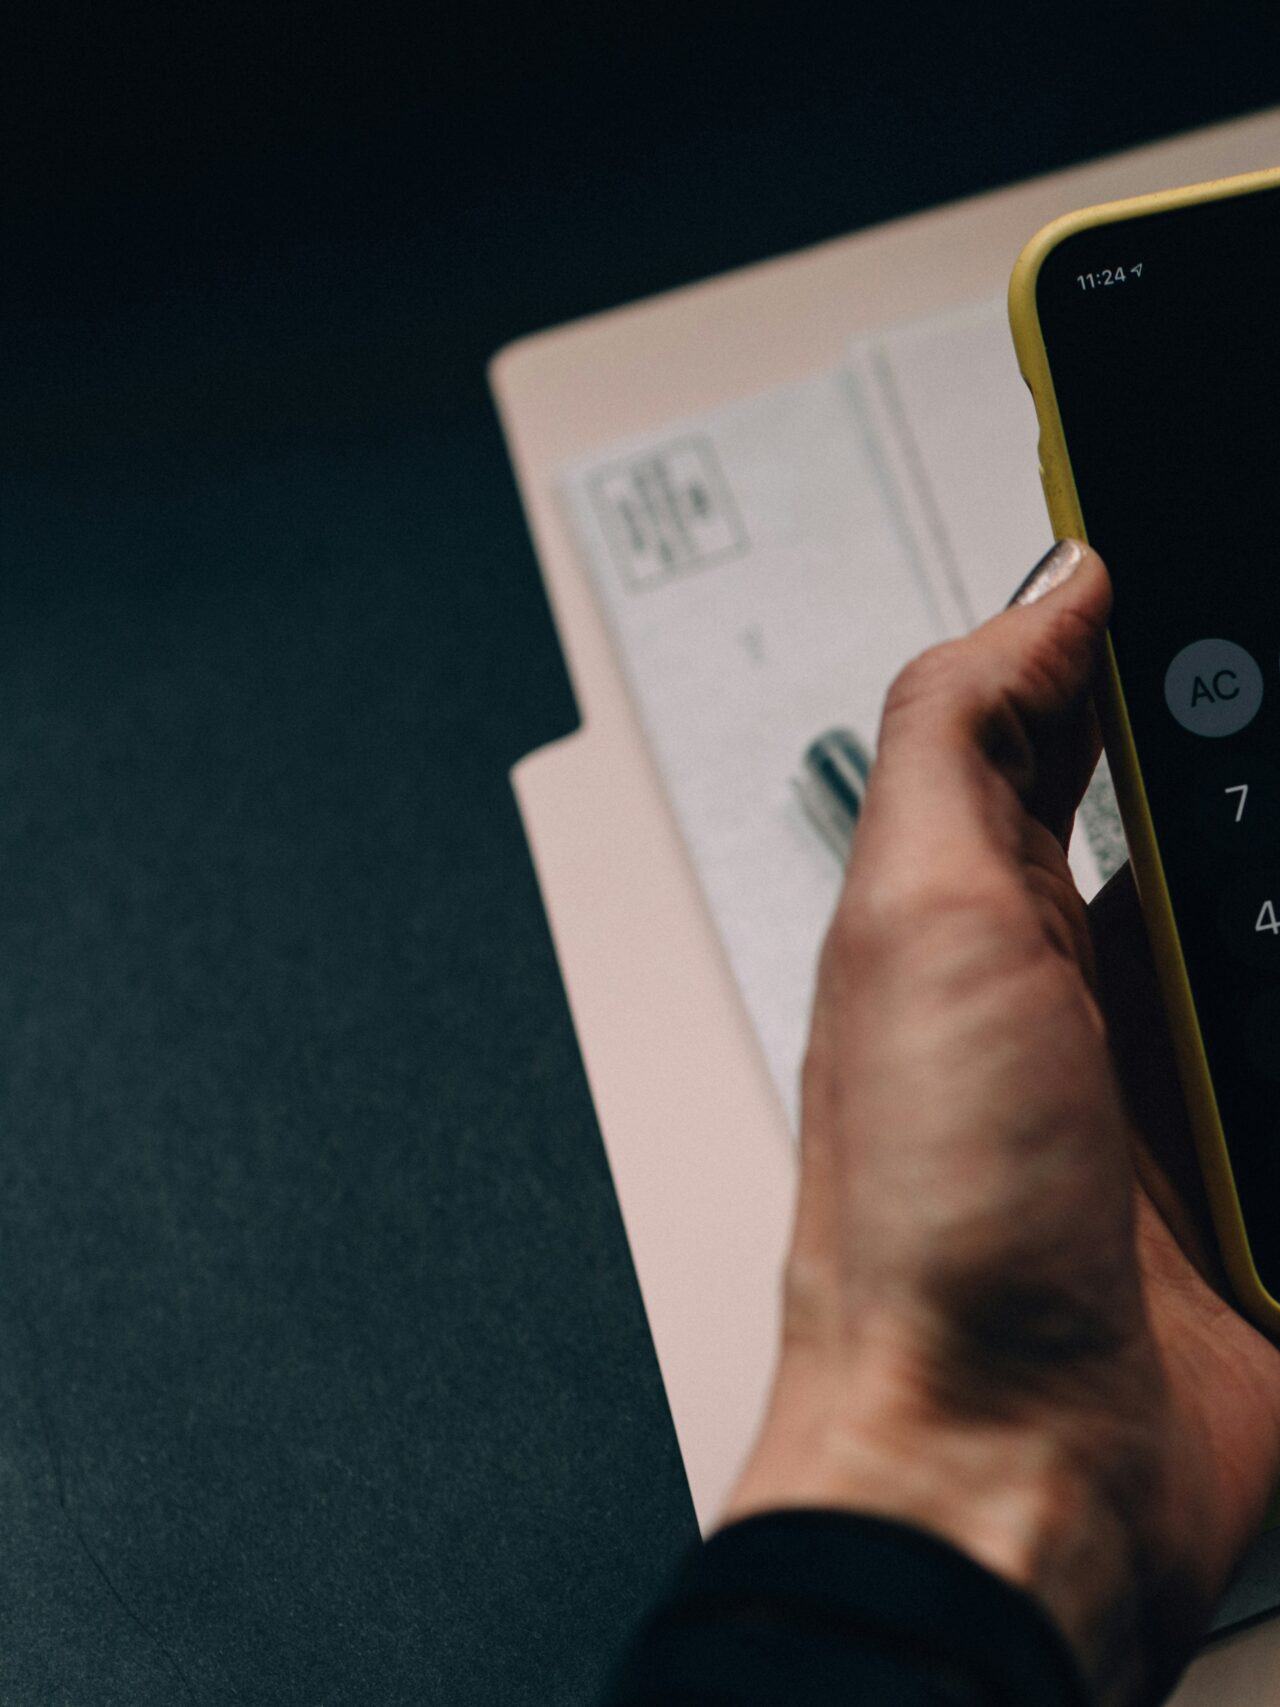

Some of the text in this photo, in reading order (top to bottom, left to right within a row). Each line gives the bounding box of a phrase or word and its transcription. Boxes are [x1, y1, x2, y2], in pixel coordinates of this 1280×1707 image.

[1076, 266, 1127, 291] 11:24
[1190, 669, 1241, 708] AC
[1224, 784, 1249, 822] 7
